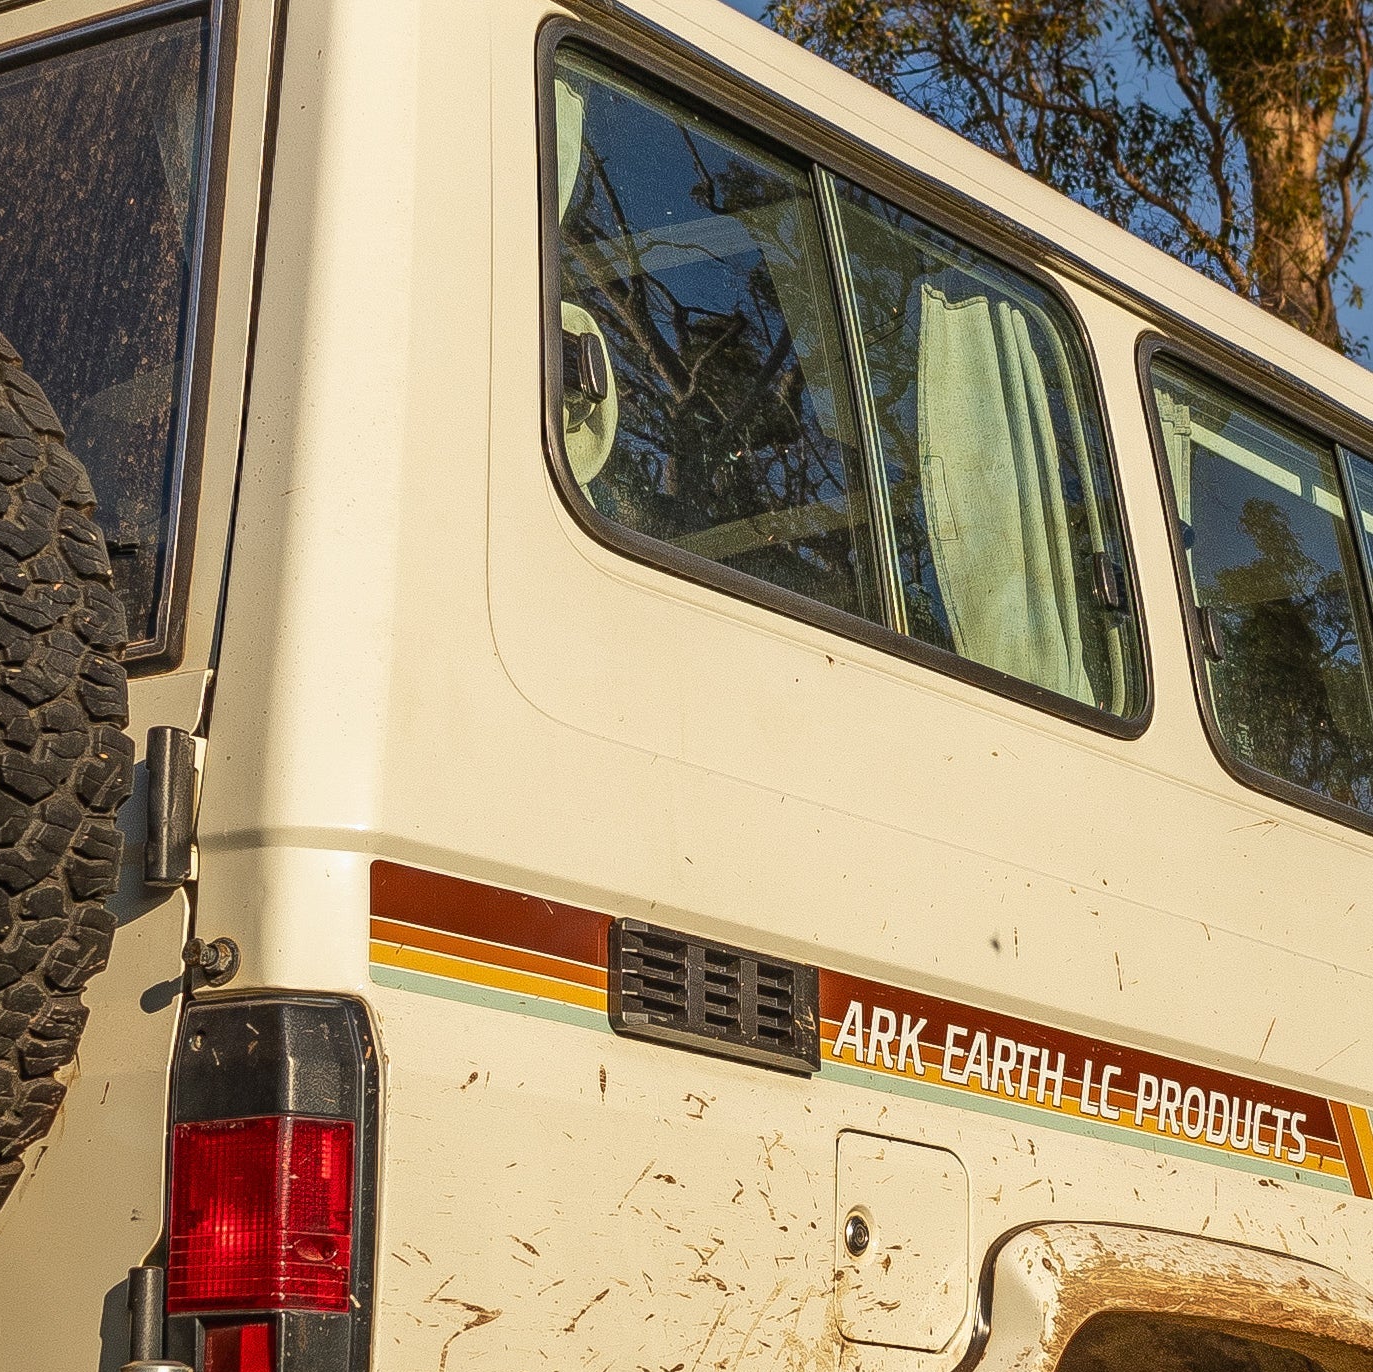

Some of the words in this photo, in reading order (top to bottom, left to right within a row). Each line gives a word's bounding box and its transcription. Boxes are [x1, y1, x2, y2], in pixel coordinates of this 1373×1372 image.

[833, 1000, 927, 1075] ARK
[941, 1021, 1065, 1108] EARTH
[1079, 1058, 1122, 1120] LC
[1133, 1073, 1308, 1164] PRODUCTS
